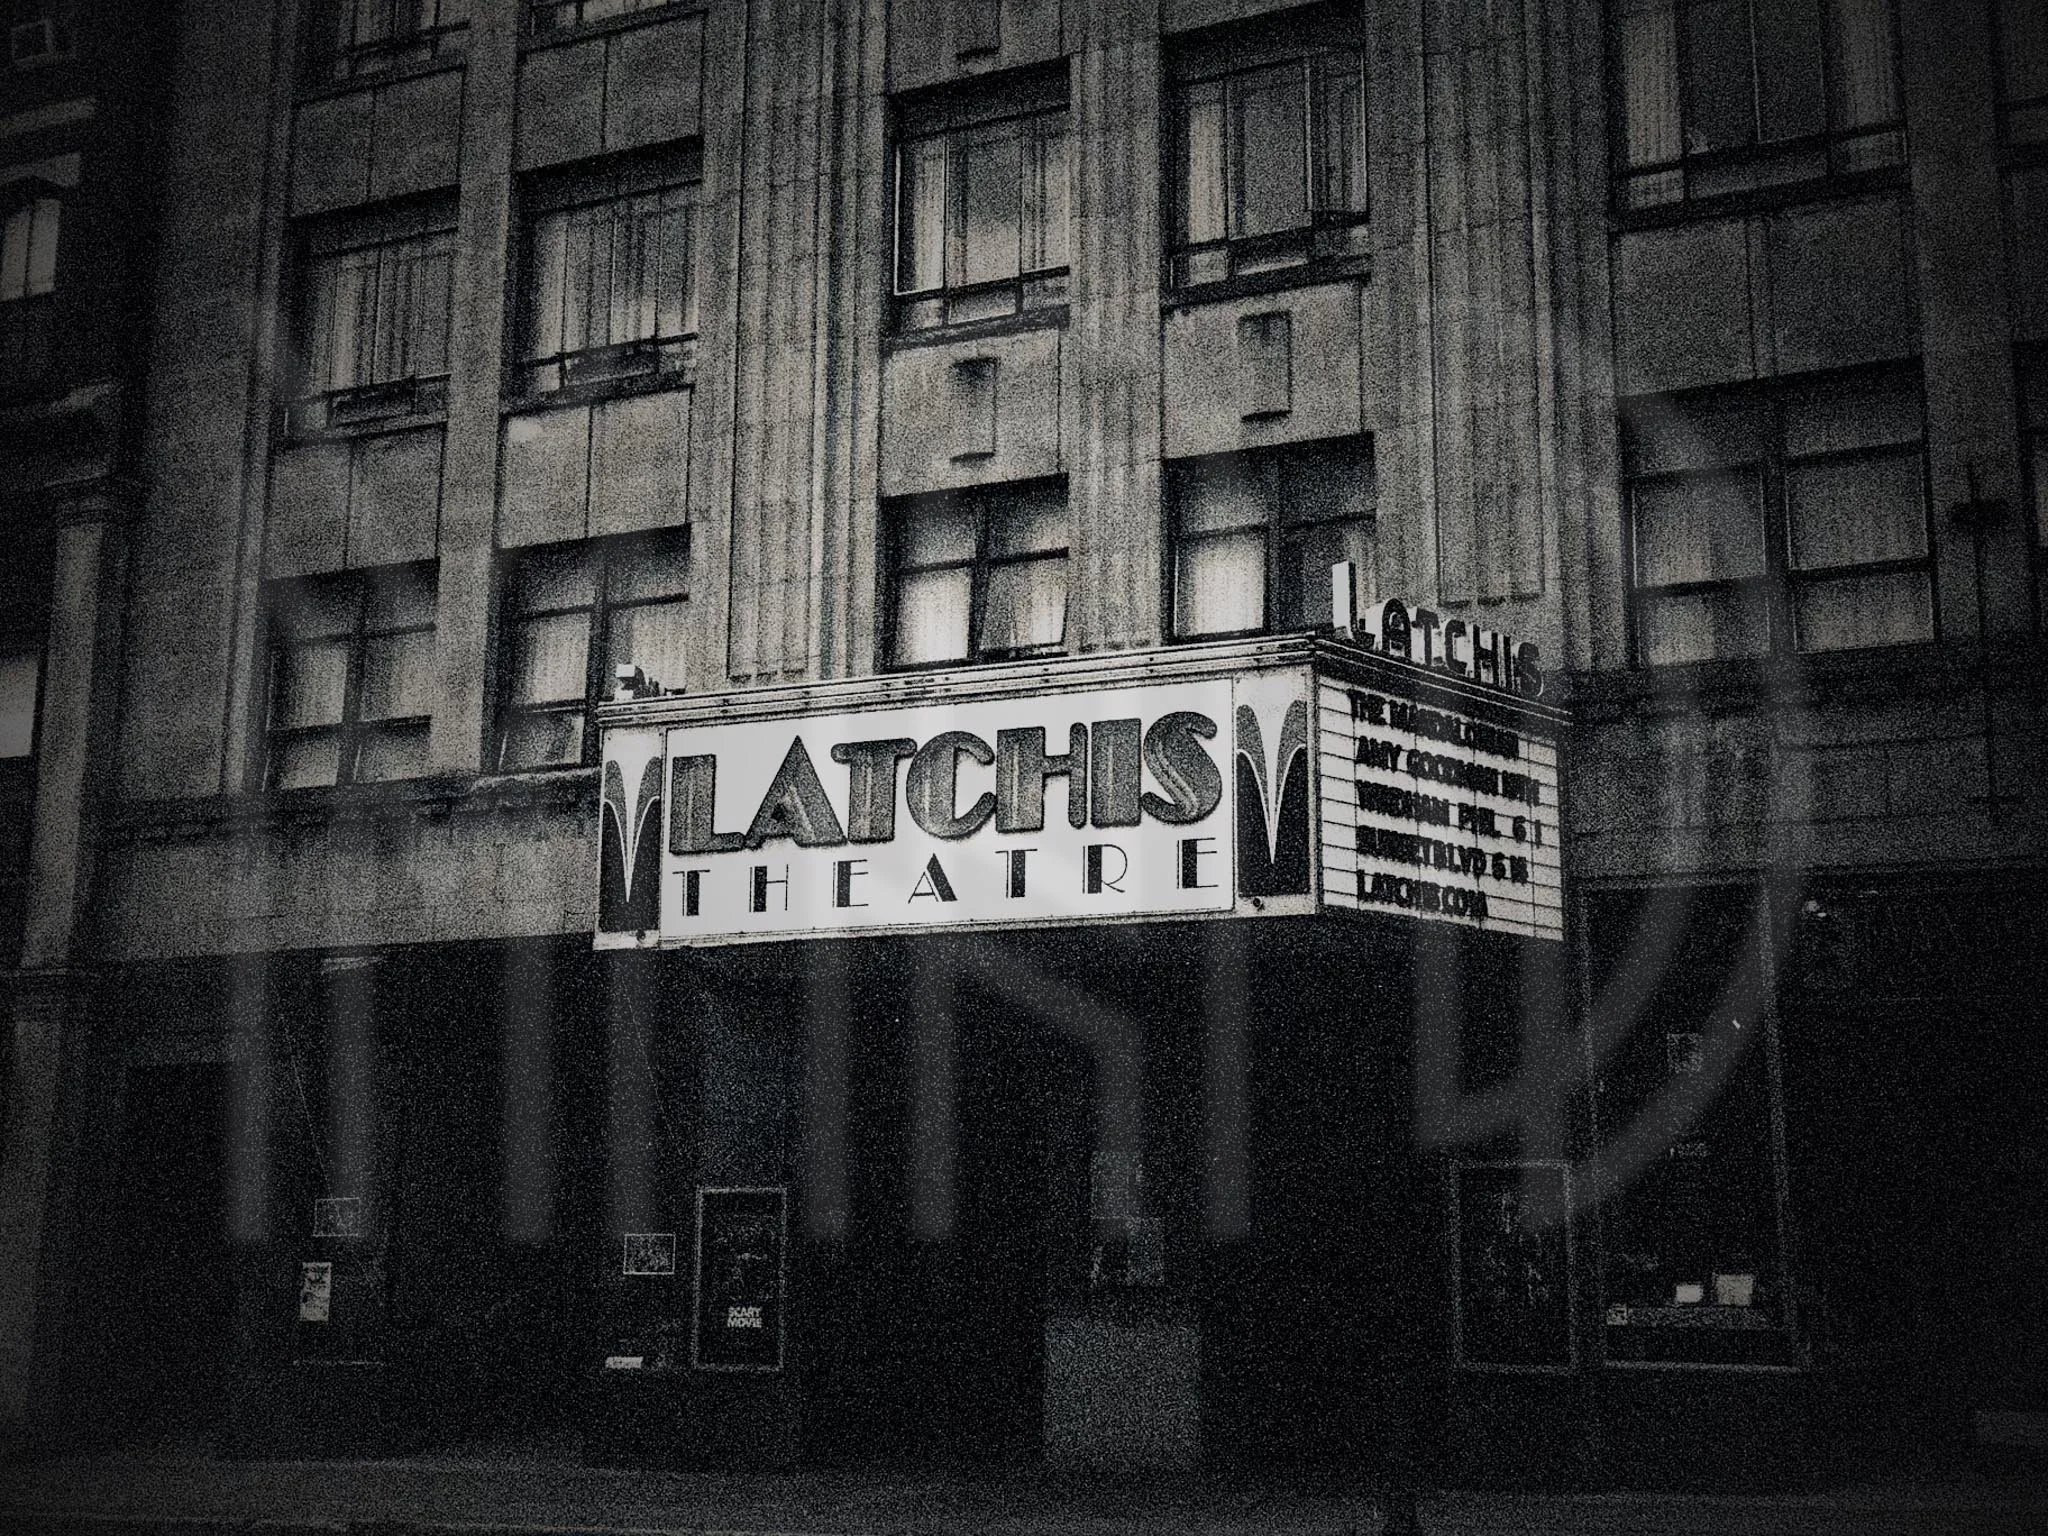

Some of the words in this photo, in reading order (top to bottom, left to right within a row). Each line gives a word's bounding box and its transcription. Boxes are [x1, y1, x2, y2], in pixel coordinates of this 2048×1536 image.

[1332, 561, 1545, 697] LATCHIS
[1355, 735, 1403, 772] AMY
[1389, 699, 1519, 760] MANDALO
[668, 709, 1222, 855] LATCHIS
[1512, 815, 1527, 843] 6
[673, 836, 1219, 917] THEATRE
